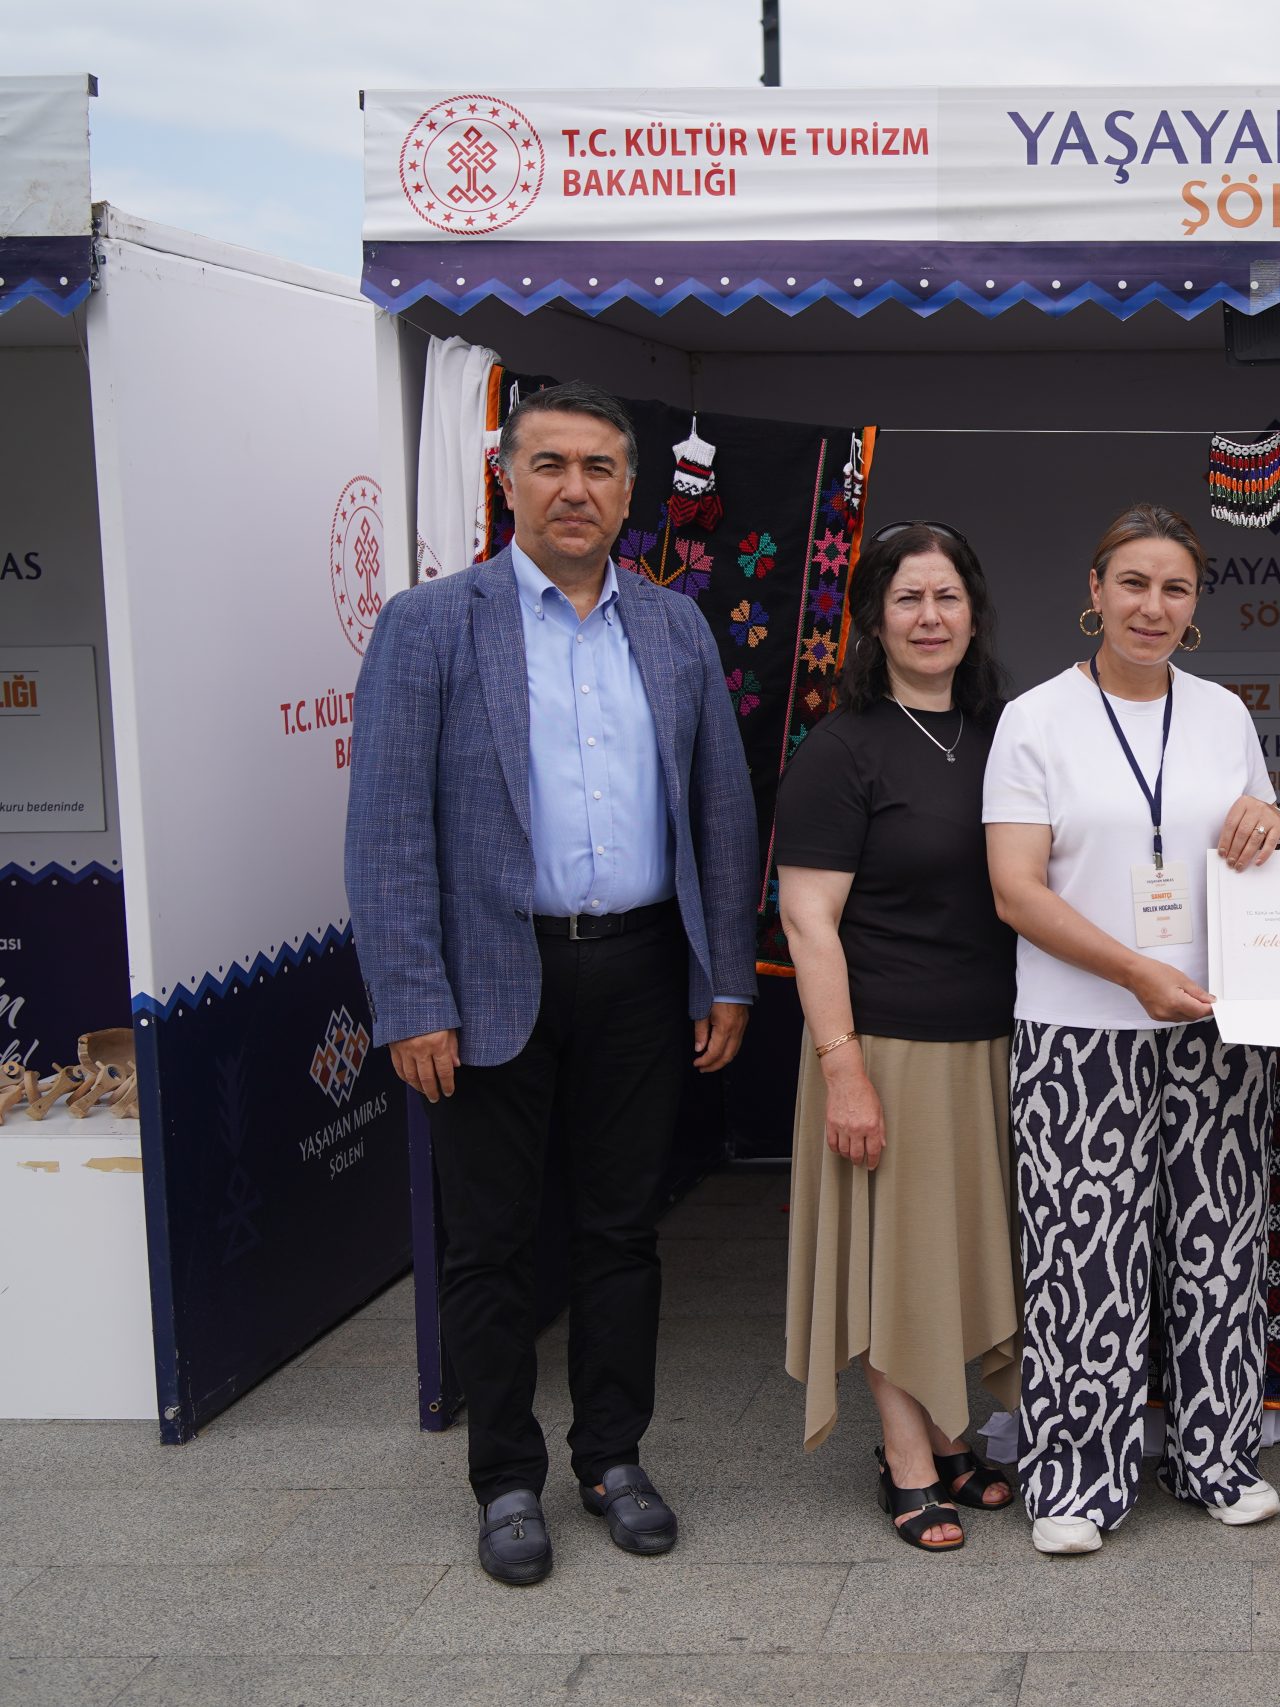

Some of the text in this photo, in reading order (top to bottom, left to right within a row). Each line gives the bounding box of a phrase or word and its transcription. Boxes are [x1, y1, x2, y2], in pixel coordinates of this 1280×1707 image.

[562, 121, 930, 158] T.C. KÜLTÜR VE TURİZM
[562, 162, 737, 197] BAKANLIĞI
[280, 702, 312, 735] T.C.
[26, 801, 85, 813] bedeninde
[299, 1112, 352, 1162] YAŞAYAN
[329, 1136, 365, 1181] ŞÖLENİ
